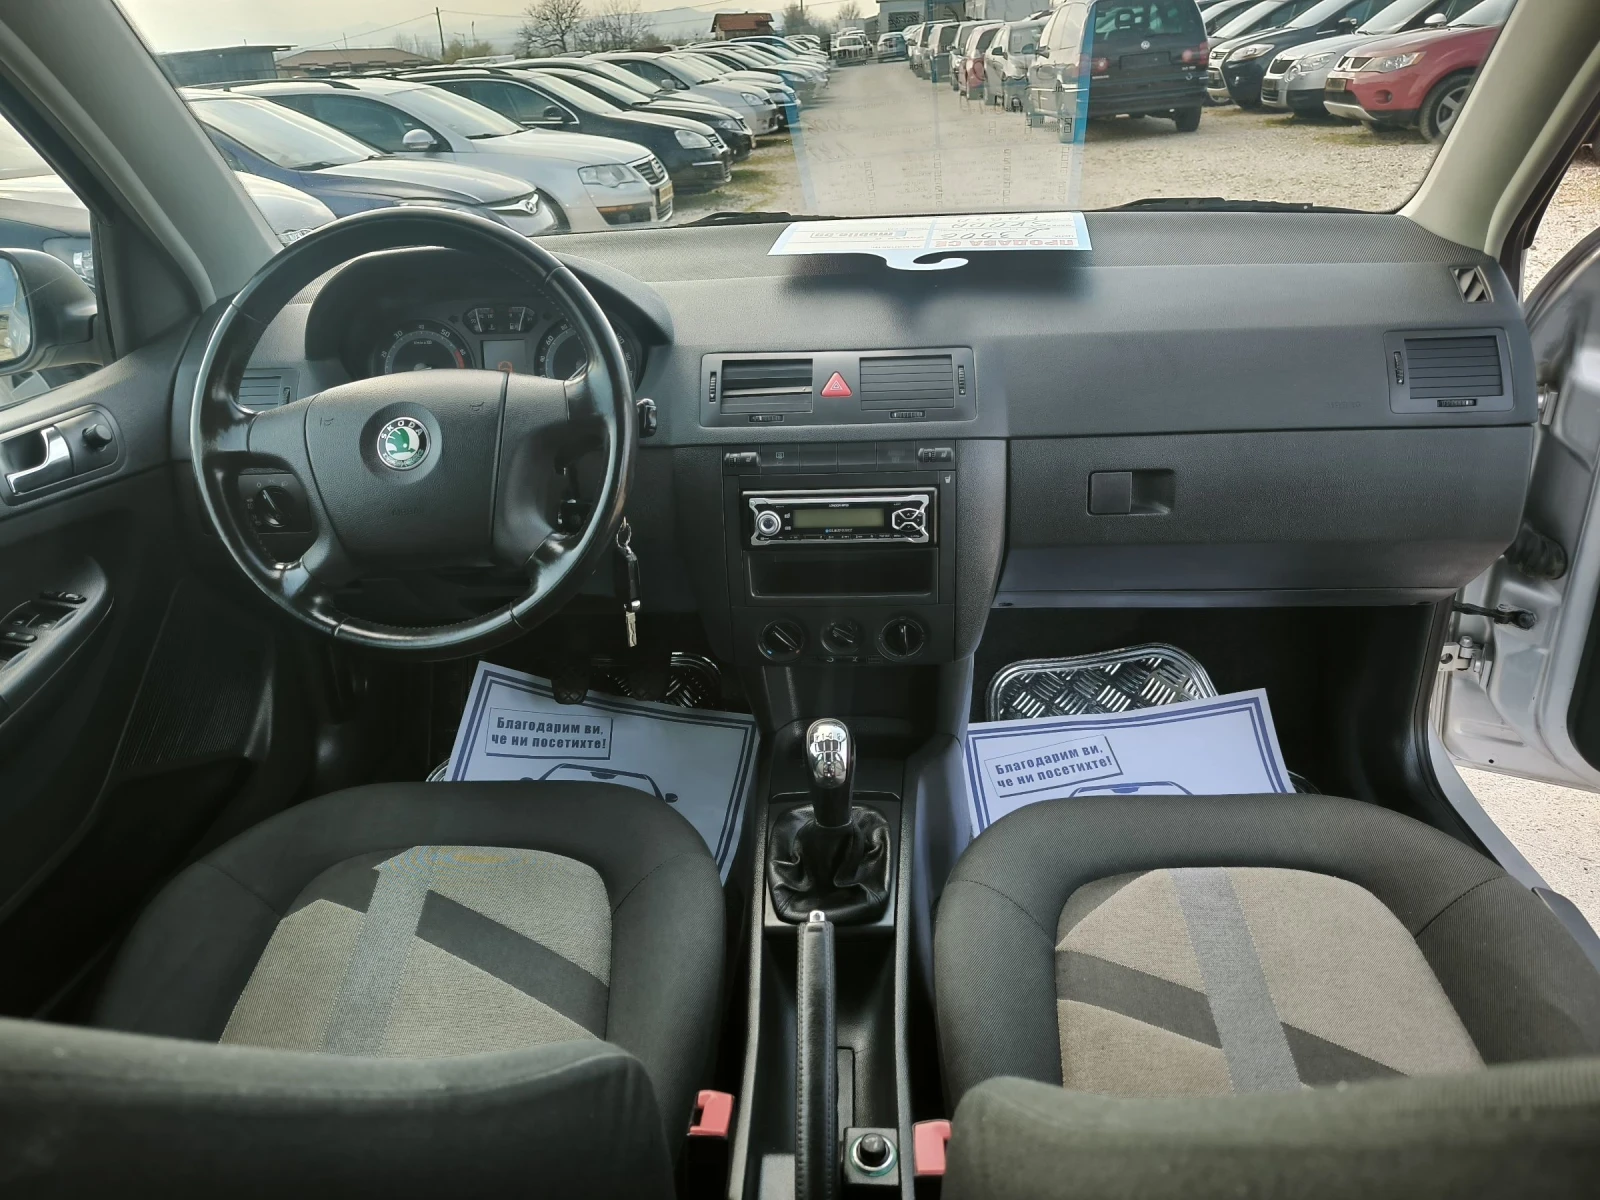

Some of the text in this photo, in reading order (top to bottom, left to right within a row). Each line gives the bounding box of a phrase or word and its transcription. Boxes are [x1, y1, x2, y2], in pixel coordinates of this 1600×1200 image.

[934, 239, 1074, 248] ПРОДАВА СЕ
[393, 330, 403, 340] 30
[440, 328, 451, 338] 50
[545, 335, 554, 346] 60
[496, 716, 604, 735] Благодарим ви,
[491, 733, 606, 749] че ни посетихте!
[995, 747, 1079, 775] Благодарим
[997, 755, 1113, 789] че ни посетихте!
